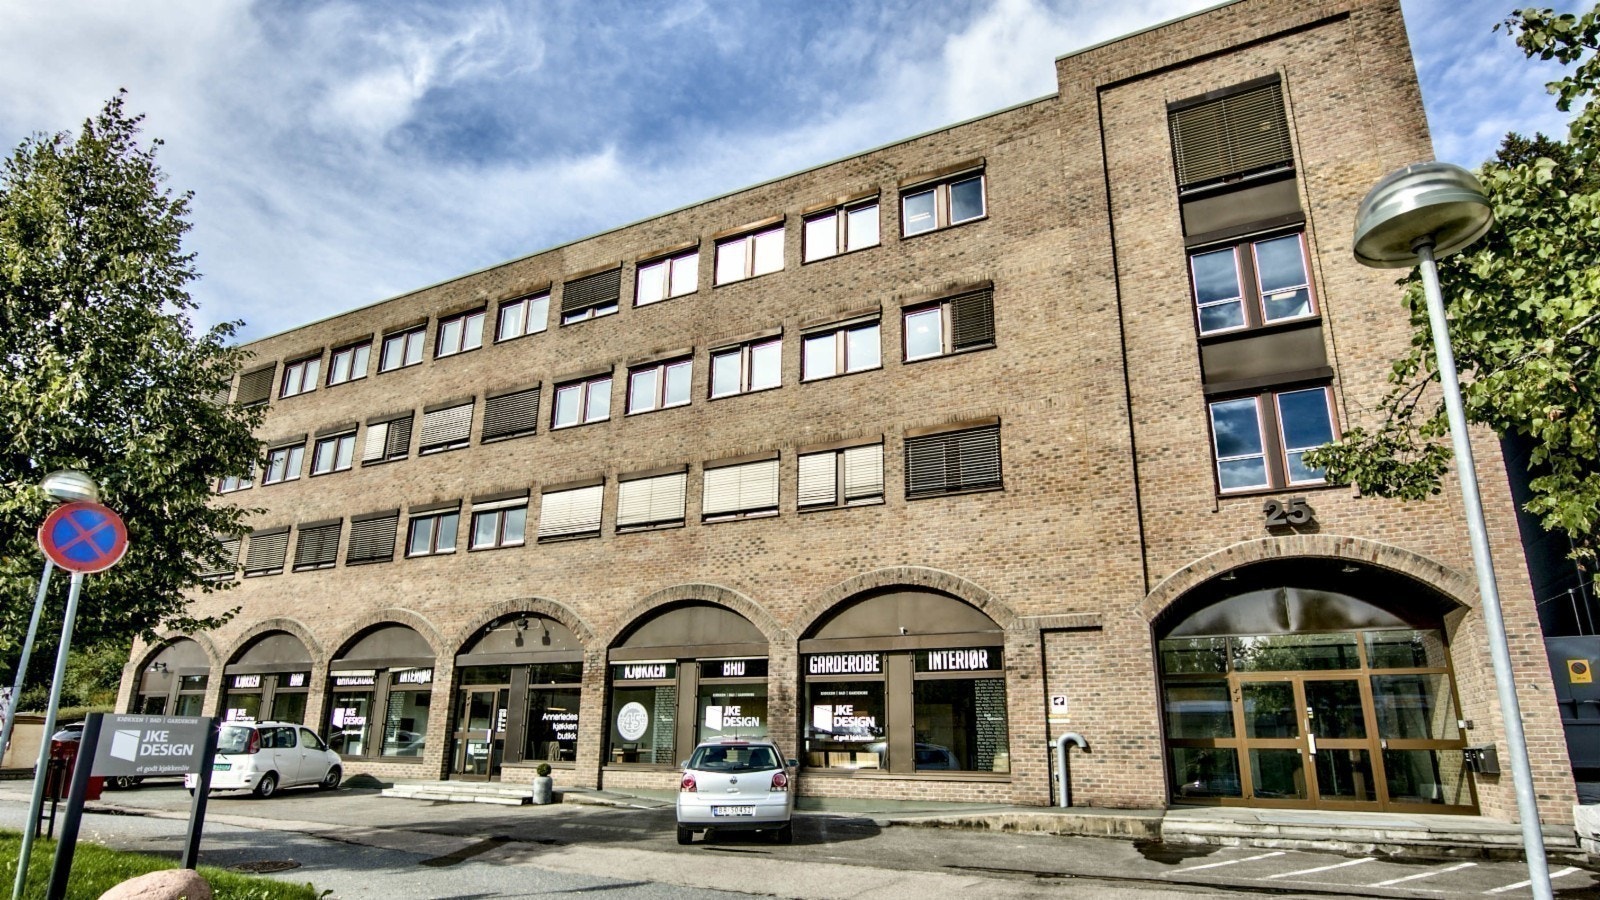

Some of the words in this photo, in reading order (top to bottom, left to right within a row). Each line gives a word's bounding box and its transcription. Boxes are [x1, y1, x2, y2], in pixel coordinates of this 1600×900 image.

[1263, 498, 1311, 525] 25
[809, 653, 880, 674] GARDEROBE
[928, 650, 988, 671] INTERIØR
[723, 705, 741, 717] JKE
[833, 704, 853, 716] JKE
[542, 713, 578, 721] Annerledes
[722, 716, 760, 727] DESIGN
[833, 716, 875, 728] DESIGN
[552, 722, 578, 731] kjøkken
[142, 730, 170, 742] JKE
[557, 732, 577, 740] butikk
[140, 744, 194, 756] DESIGN
[144, 765, 158, 773] godt
